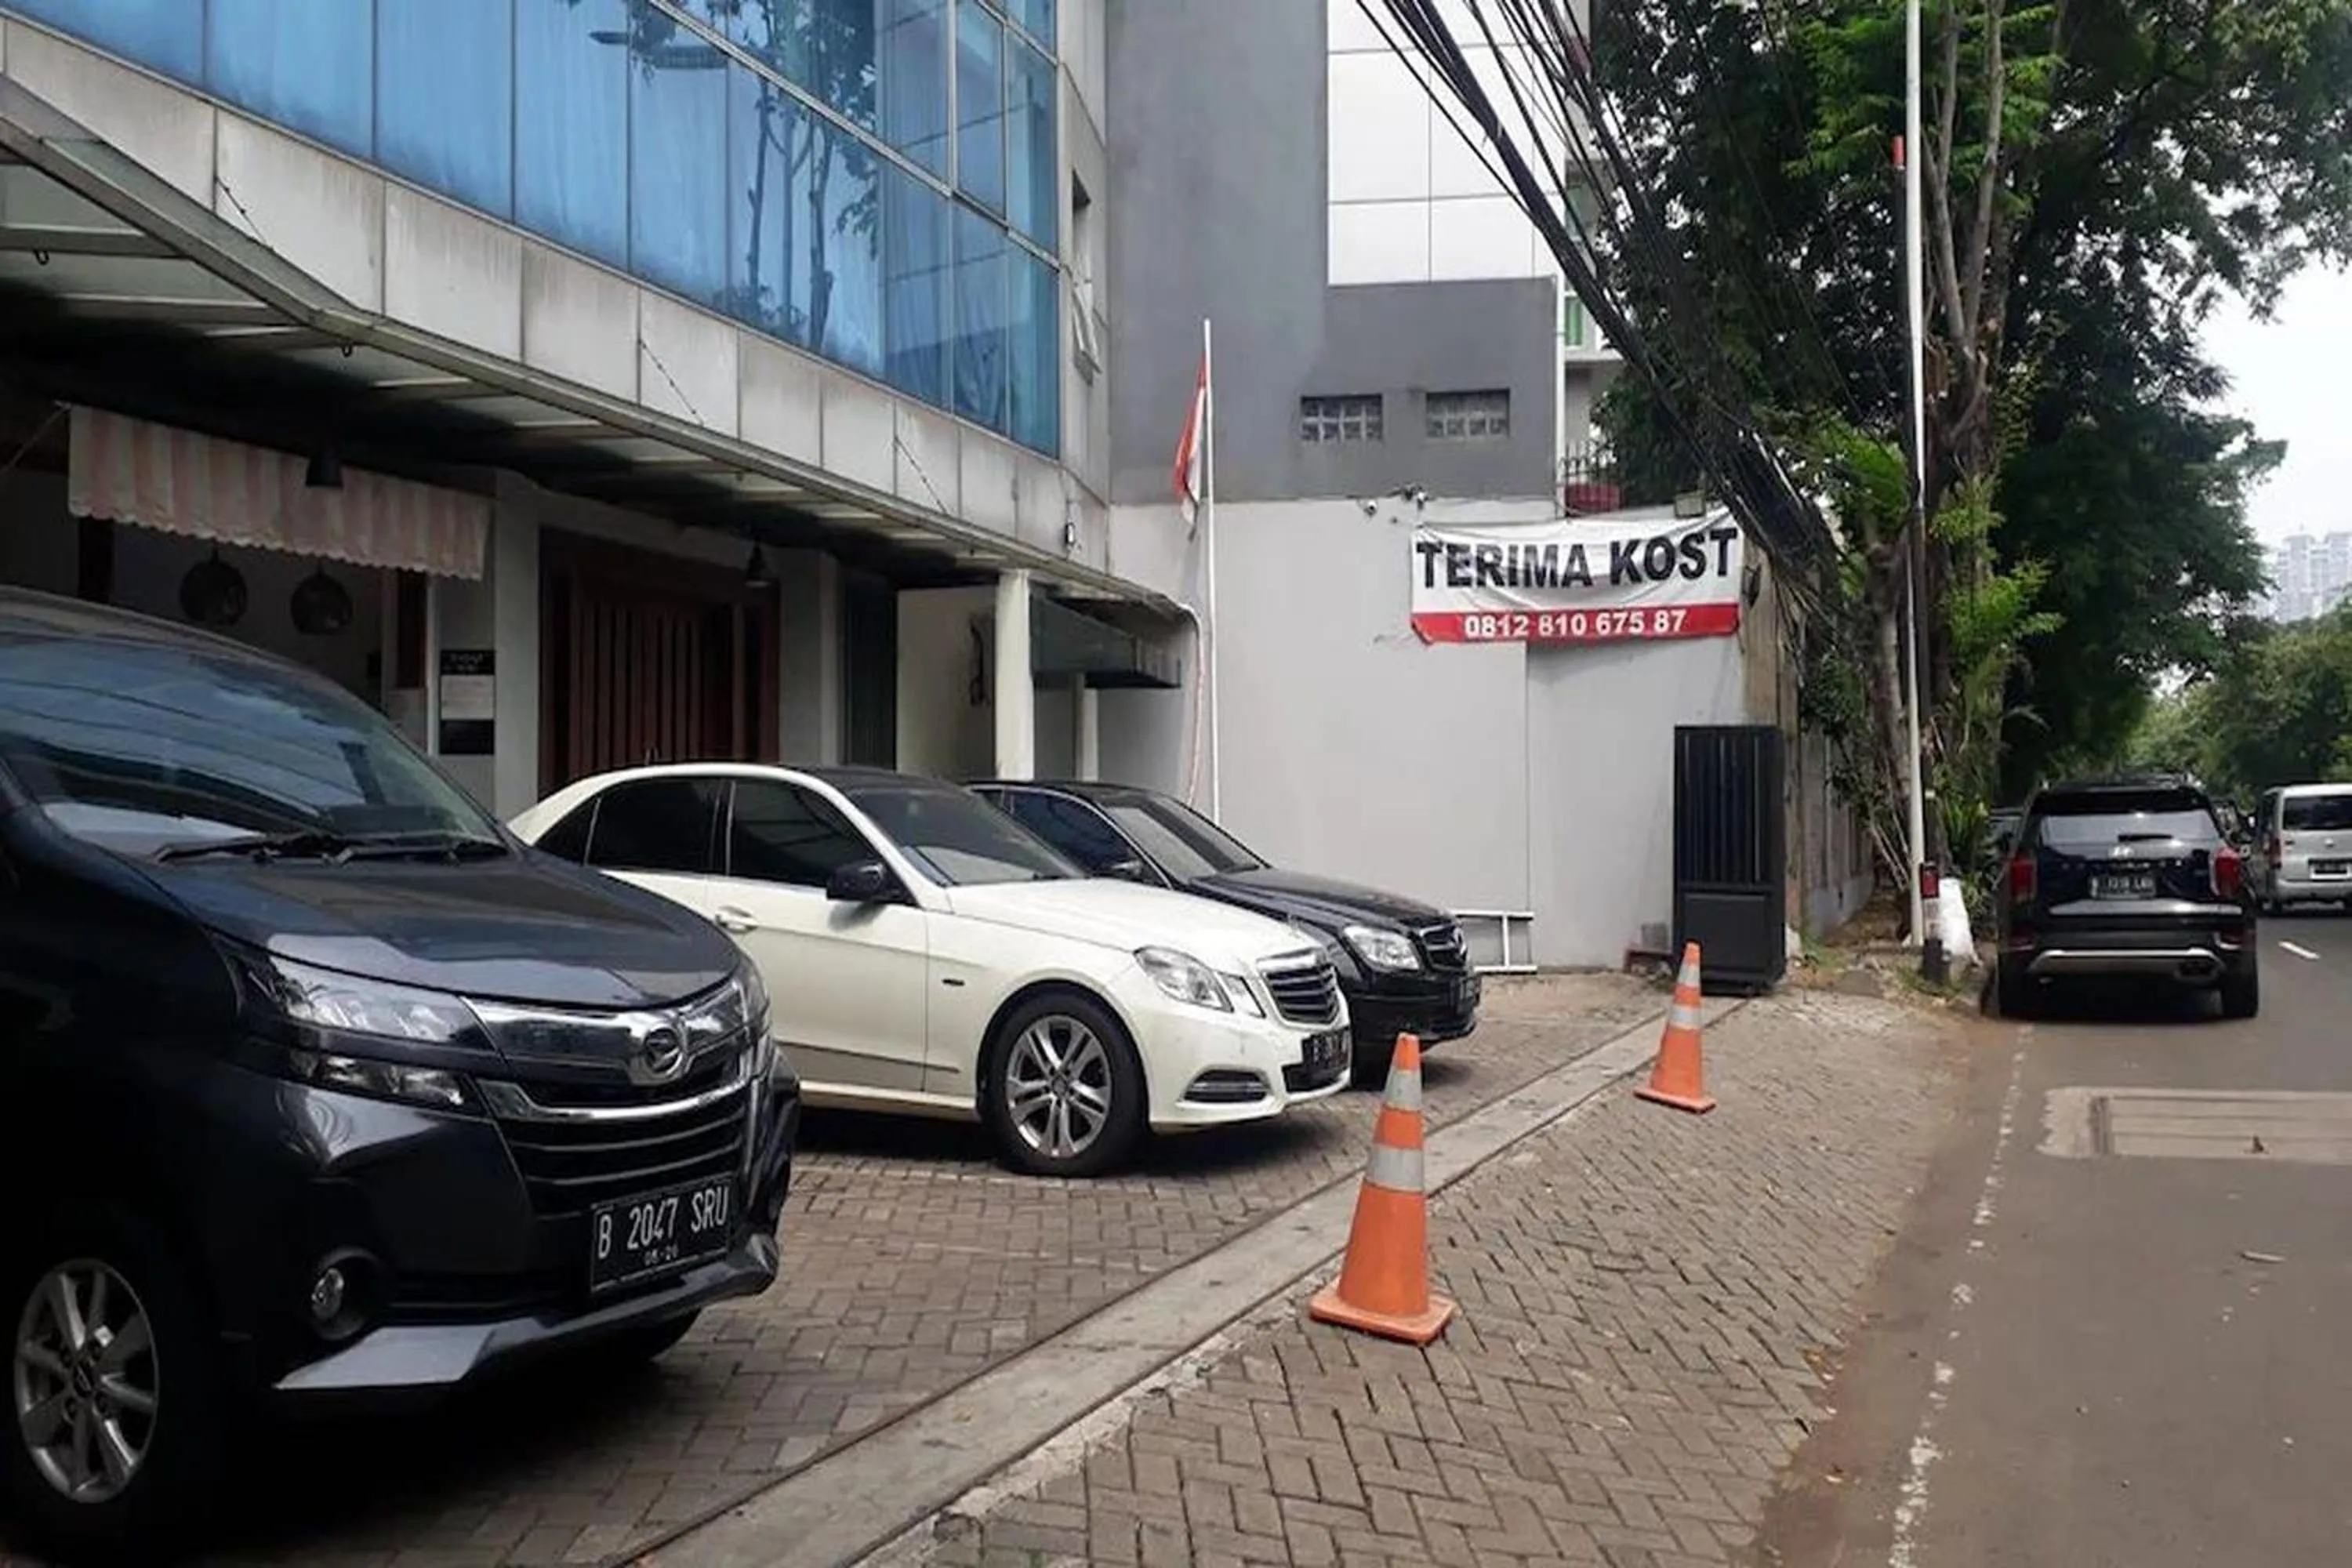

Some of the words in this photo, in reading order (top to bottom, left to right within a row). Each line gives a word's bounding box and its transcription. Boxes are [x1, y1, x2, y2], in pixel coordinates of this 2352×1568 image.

[1416, 540, 1592, 588] TERIMA
[1610, 528, 1737, 585] KOST
[1464, 615, 1528, 637] 0812
[1537, 612, 1588, 637] 810
[1595, 610, 1645, 634] 675
[1654, 608, 1687, 633] 87
[598, 1214, 612, 1259] B
[626, 1197, 679, 1250] 2047
[691, 1185, 729, 1233] SRU
